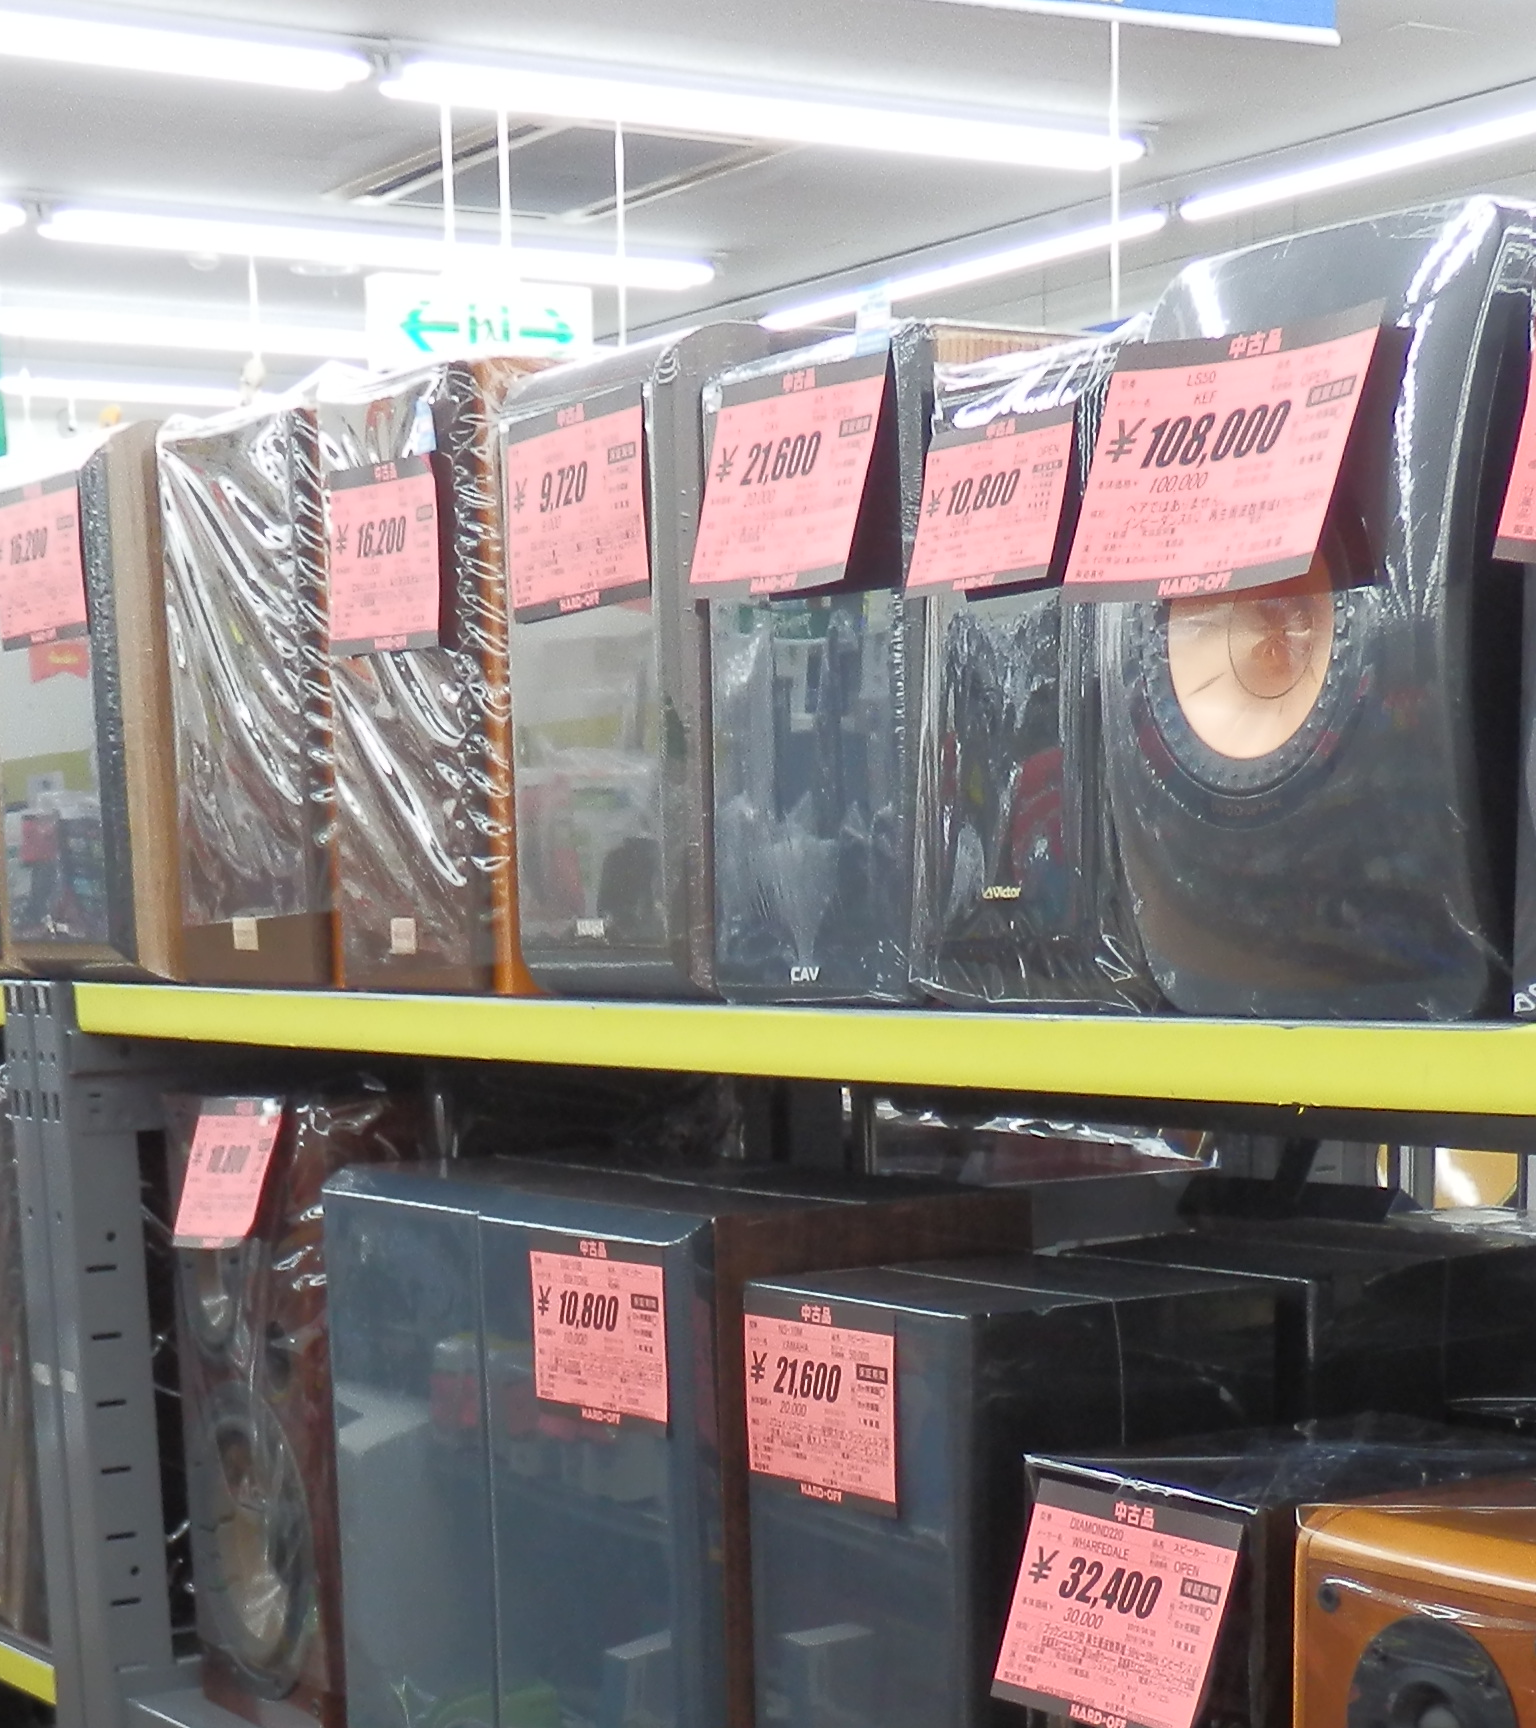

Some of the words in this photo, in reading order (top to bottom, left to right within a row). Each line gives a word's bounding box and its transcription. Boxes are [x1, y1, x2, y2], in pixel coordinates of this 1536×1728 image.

[1229, 328, 1283, 359] 中古品
[780, 368, 816, 395] 中古品
[1194, 391, 1217, 405] KEF
[556, 402, 585, 427] 中古品
[985, 419, 1016, 438] 中古品
[1105, 418, 1146, 463] ¥
[1141, 400, 1291, 469] 108,000
[715, 446, 740, 484] ¥
[740, 431, 823, 488] 21,600
[513, 479, 529, 514] ¥
[538, 461, 587, 514] 9,720
[926, 488, 945, 519] ¥
[946, 469, 1021, 519] 10,800
[8, 528, 50, 566] 16,200
[335, 524, 350, 554] ¥
[356, 519, 407, 558] 16,200
[993, 886, 1022, 899] Victor
[790, 966, 820, 982] CAV
[578, 1240, 608, 1258] 中古品
[536, 1284, 552, 1317] ¥
[557, 1288, 620, 1335] 10,800
[800, 1302, 833, 1326] 中古品
[749, 1350, 768, 1386] ¥
[772, 1354, 842, 1407] 21,600
[1070, 1516, 1124, 1541] DIAMOND220
[1114, 1501, 1155, 1529] 中古品
[1072, 1537, 1129, 1562] WHARFEDALE
[1028, 1546, 1060, 1584] ¥
[1059, 1556, 1164, 1620] 32,400
[1172, 1561, 1200, 1578] OPEN
[1062, 1607, 1103, 1630] 30,000
